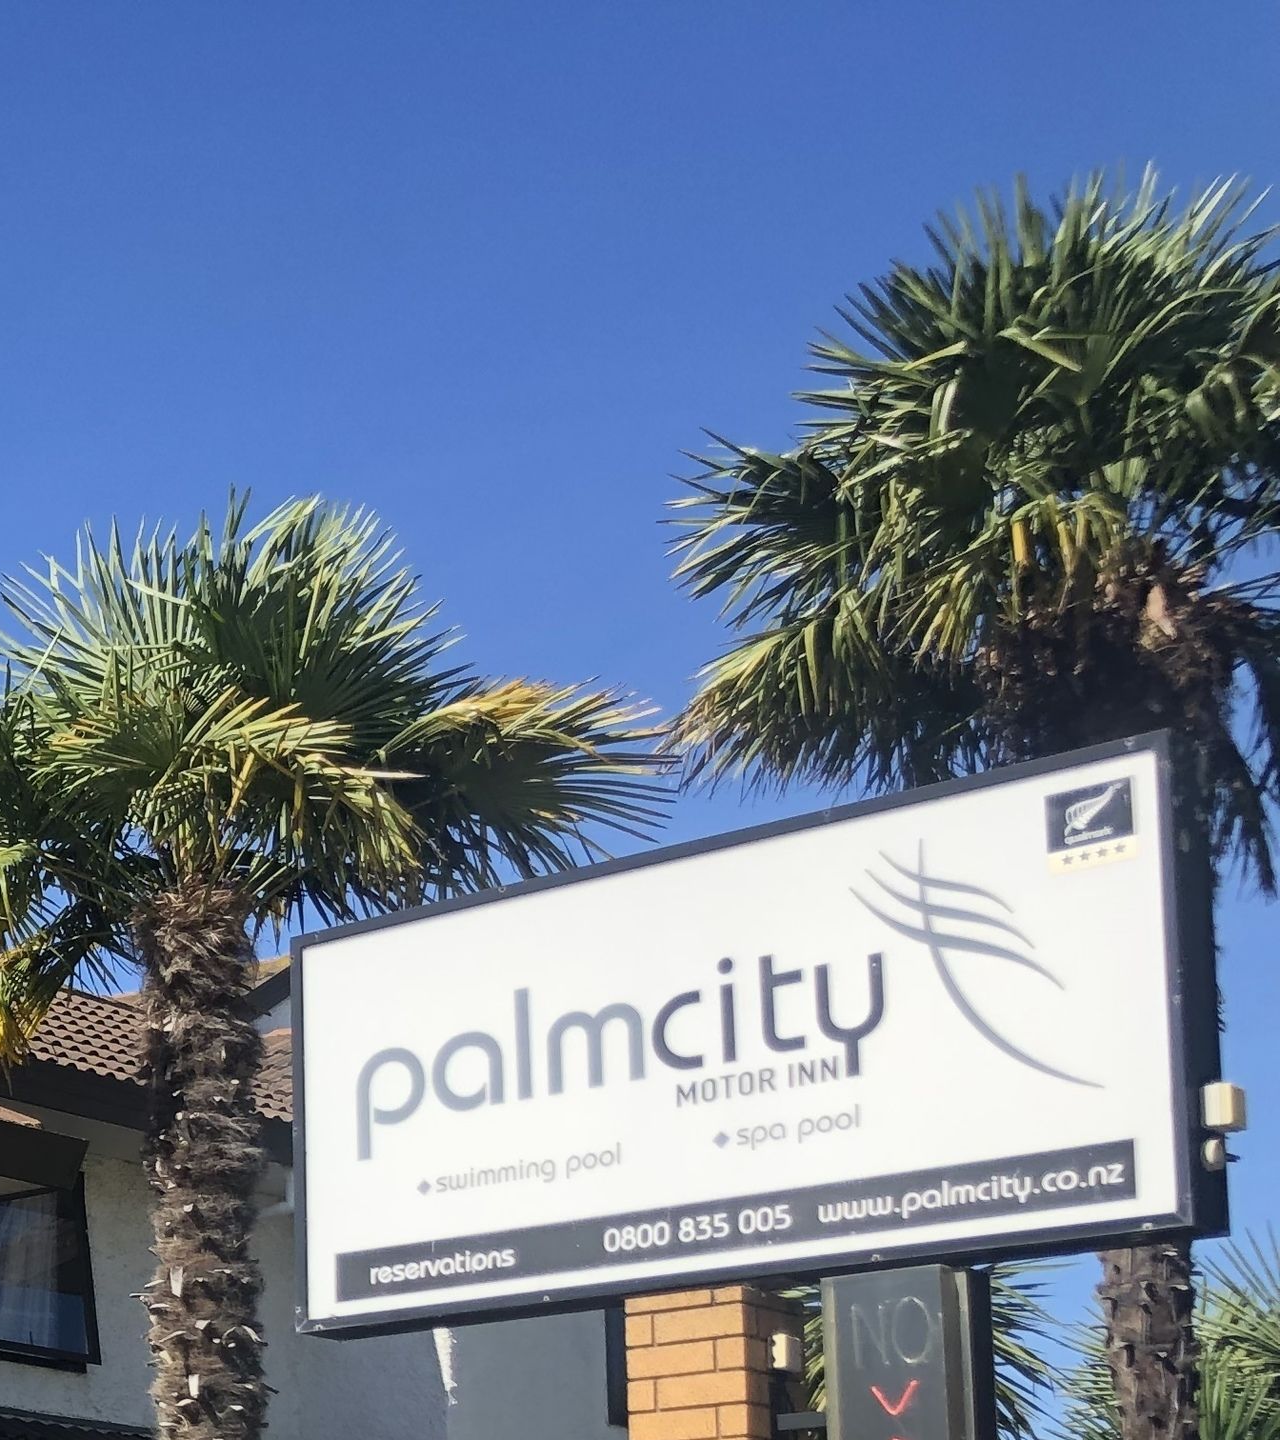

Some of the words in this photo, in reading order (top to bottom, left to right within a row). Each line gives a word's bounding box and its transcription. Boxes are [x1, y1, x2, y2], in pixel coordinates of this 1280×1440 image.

[356, 951, 885, 1161] palmcity
[676, 1067, 776, 1107] MOTOR
[787, 1055, 839, 1088] INN
[735, 1122, 787, 1150] spa
[797, 1103, 861, 1144] pool
[435, 1158, 557, 1193] swimming
[565, 1141, 622, 1179] pool
[368, 1246, 517, 1285] reservations
[602, 1221, 672, 1254] 0800
[678, 1211, 730, 1244] 835
[737, 1203, 793, 1236] 005
[817, 1161, 1126, 1220] www.palmcity.co.nz
[849, 1295, 933, 1370] NO
